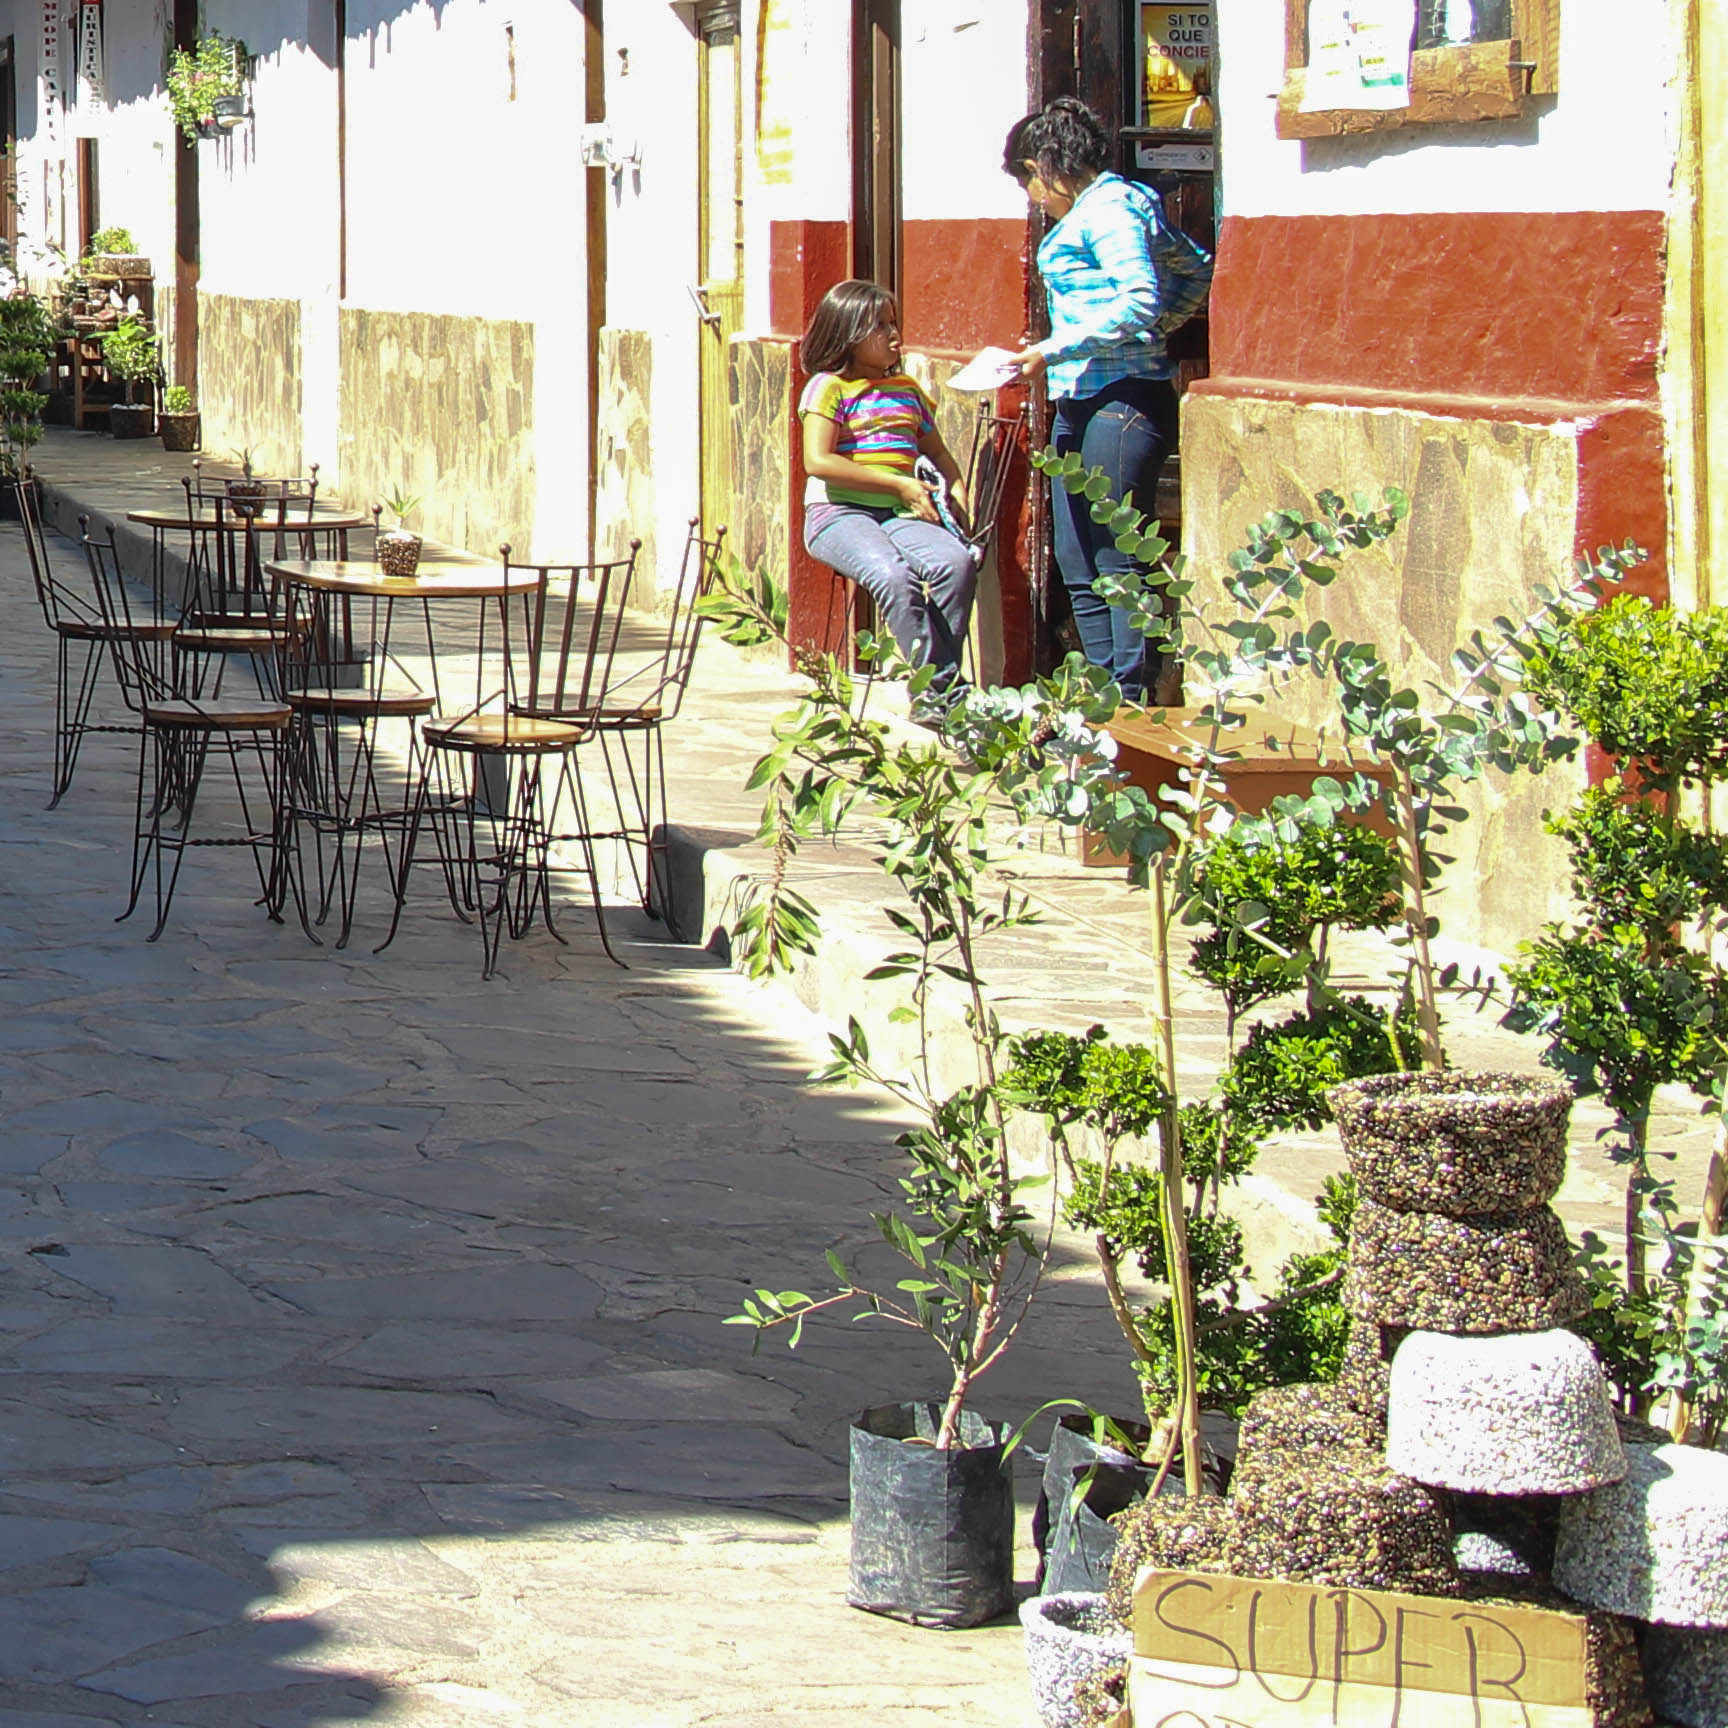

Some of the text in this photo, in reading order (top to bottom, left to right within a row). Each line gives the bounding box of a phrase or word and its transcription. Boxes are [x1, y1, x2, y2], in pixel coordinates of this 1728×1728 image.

[1167, 13, 1182, 27] SI
[1168, 29, 1203, 44] QUE
[1147, 44, 1211, 59] CONCIE
